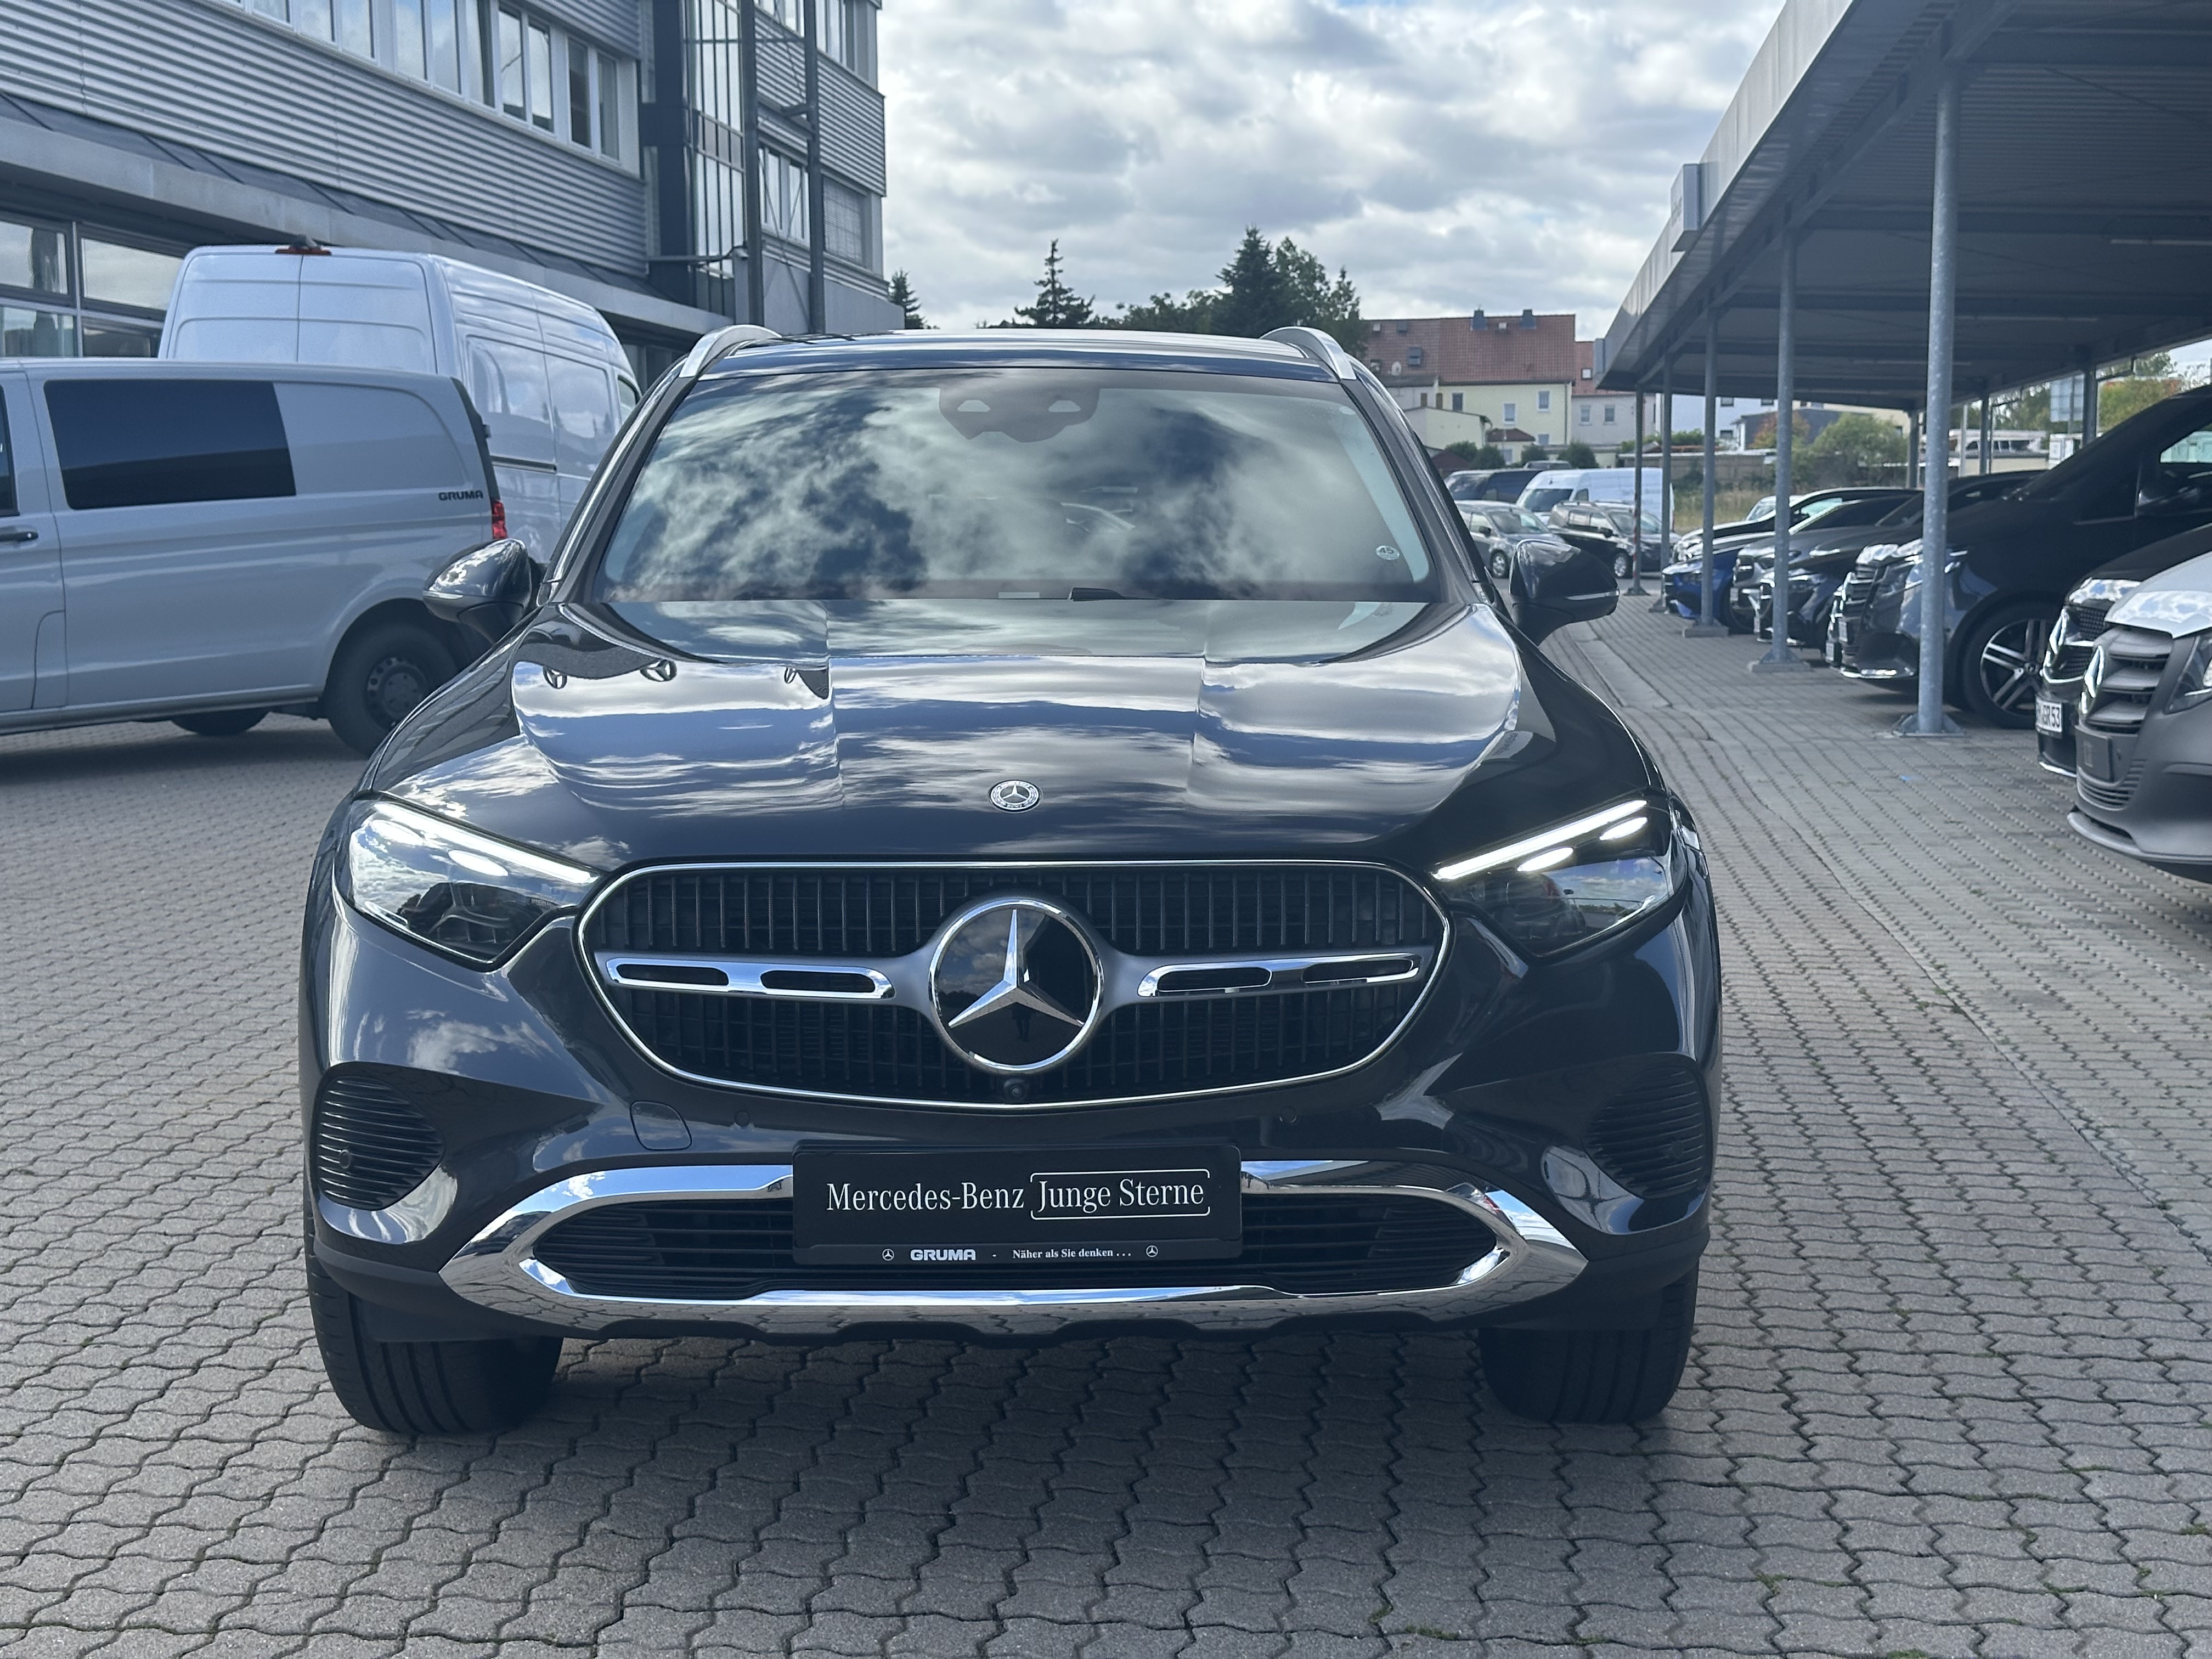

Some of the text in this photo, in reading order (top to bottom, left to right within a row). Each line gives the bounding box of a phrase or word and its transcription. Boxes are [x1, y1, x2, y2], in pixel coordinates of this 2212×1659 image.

[438, 490, 484, 501] GRUMA
[826, 1178, 1204, 1214] Mercedes-Benz Junge Sterne
[910, 1249, 976, 1261] GRUMA
[1012, 1249, 1042, 1259] Näher
[1045, 1248, 1059, 1258] als
[1060, 1248, 1076, 1258] Sie
[1078, 1248, 1113, 1257] denken
